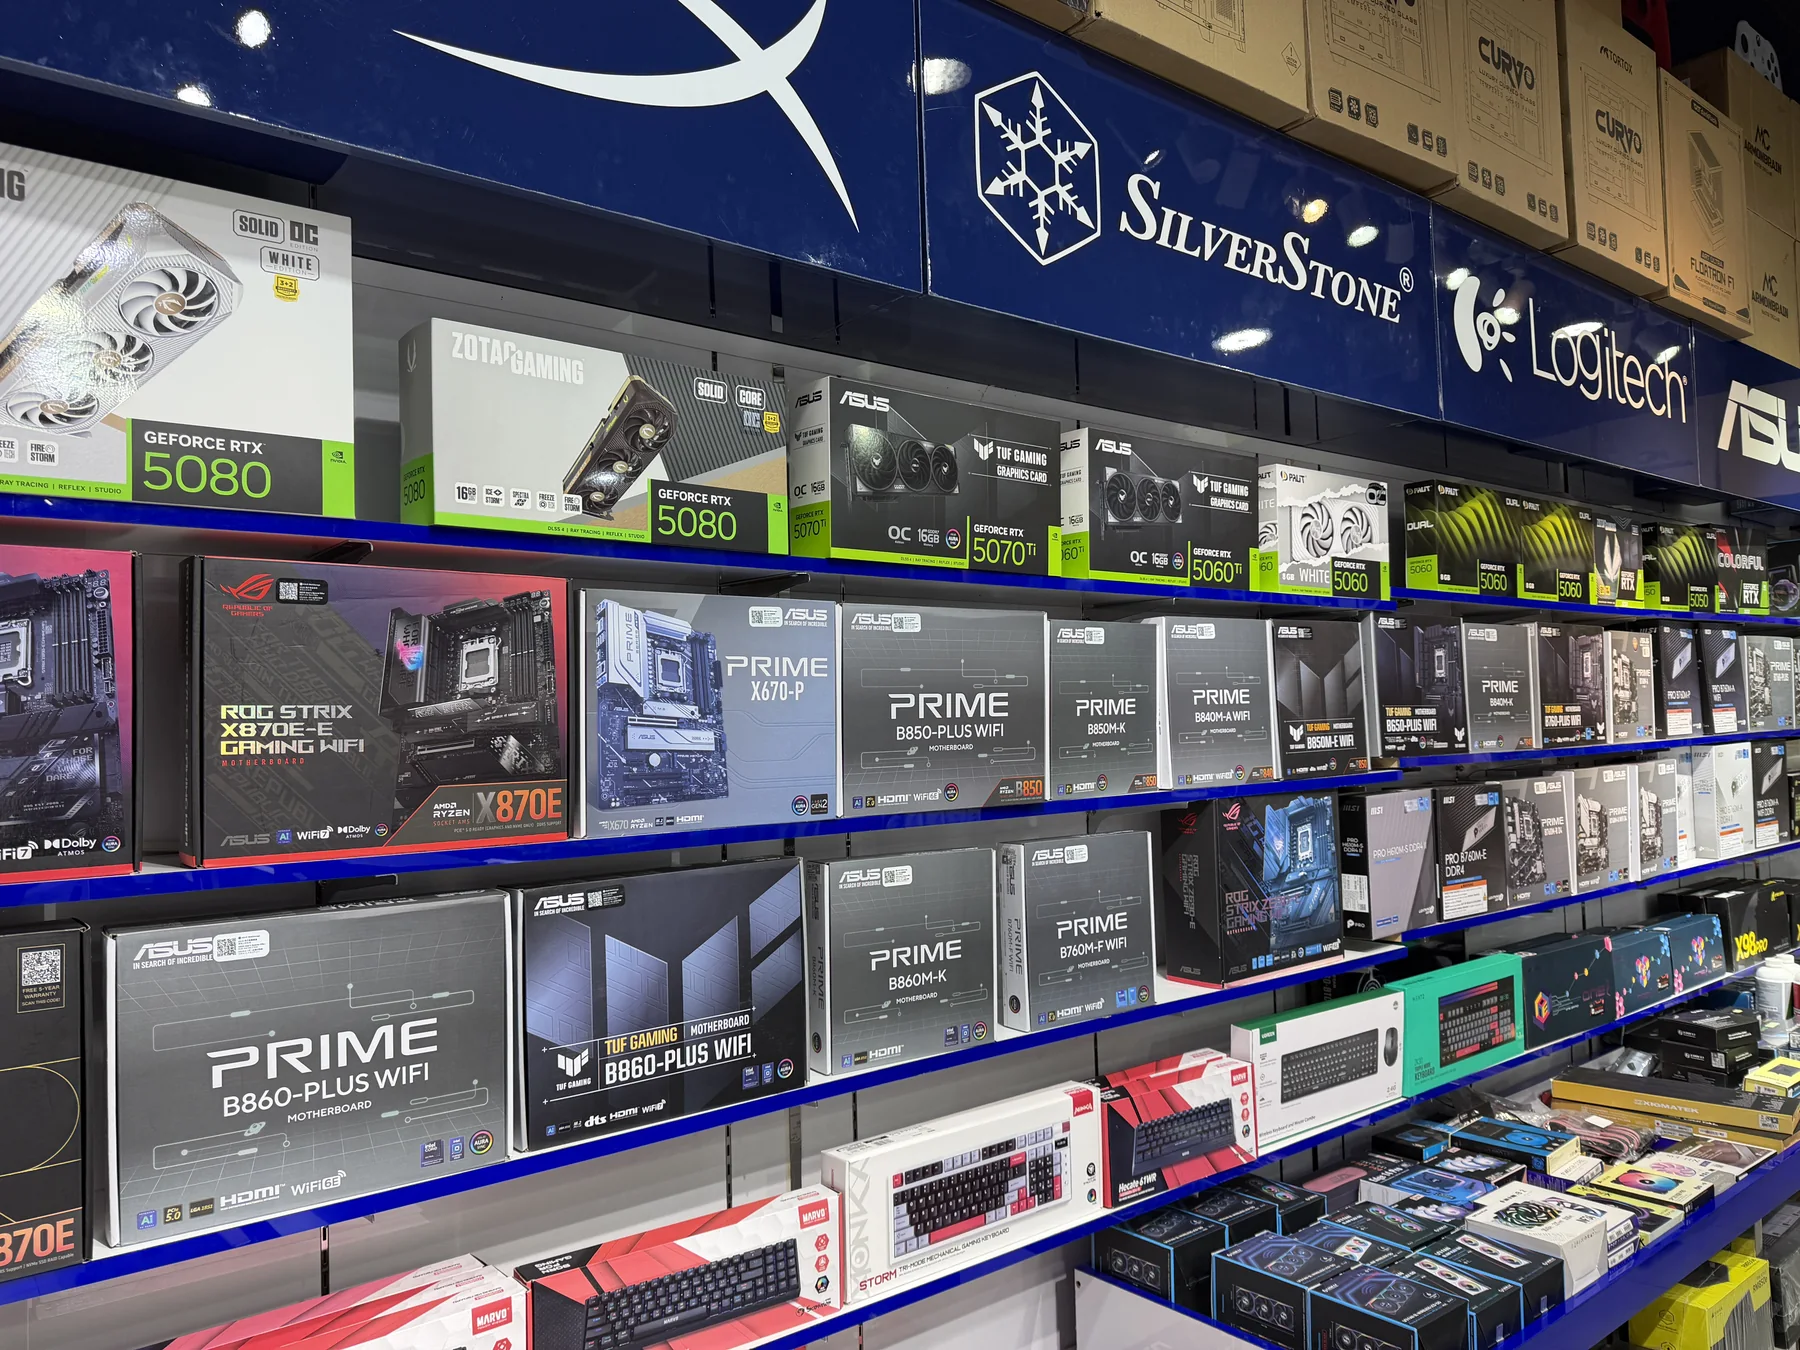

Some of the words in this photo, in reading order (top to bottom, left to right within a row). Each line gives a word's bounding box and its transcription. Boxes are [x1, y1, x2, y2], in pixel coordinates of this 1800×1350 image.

[1478, 36, 1535, 90] CURVO
[1595, 108, 1642, 155] CURVO
[239, 215, 279, 238] SOLID
[289, 220, 318, 246] OC
[268, 250, 312, 271] WHITE
[451, 331, 516, 365] ZOTAC
[511, 351, 585, 385] GAMING
[1529, 297, 1687, 423] Logitech
[697, 381, 724, 400] SOLID
[739, 389, 762, 406] CORE
[794, 390, 823, 409] ASUS
[839, 390, 890, 413] ASUS
[30, 443, 45, 452] FIRE
[143, 430, 226, 451] GEFORCE
[229, 441, 264, 455] RTX
[1095, 438, 1132, 456] ASUS
[30, 452, 56, 463] STORM
[996, 445, 1012, 460] TUF
[1013, 448, 1048, 467] GAMING
[142, 451, 272, 499] 5080
[996, 465, 1029, 480] GRAPHICS
[1030, 468, 1048, 483] CARD
[16, 480, 49, 489] TRACING
[58, 484, 86, 492] REFLEX
[94, 486, 122, 494] STUDIO
[403, 478, 426, 506] 5080
[1209, 481, 1223, 493] TUF
[1223, 483, 1249, 498] GAMING
[658, 488, 709, 503] GEFORCE
[710, 495, 732, 506] RTX
[564, 503, 581, 513] STORM
[657, 504, 737, 541] 5080
[973, 523, 1007, 536] GEFORCE
[1008, 527, 1024, 538] RTX
[1406, 520, 1434, 531] DUAL
[972, 537, 1025, 566] 5070
[1026, 542, 1036, 556] Ti
[1193, 547, 1218, 558] GEFORCE
[1219, 550, 1232, 559] RTX
[1410, 564, 1433, 575] 5060
[1717, 552, 1765, 571] COLORFUL
[1192, 560, 1233, 584] 5060
[1234, 561, 1242, 575] Ti
[1299, 567, 1330, 584] WHITE
[1334, 571, 1368, 592] 5060
[1480, 572, 1508, 591] 5060
[1559, 581, 1582, 598] 5060
[1621, 578, 1635, 591] RTX
[1690, 593, 1708, 608] 5050
[1743, 590, 1759, 604] RTX
[784, 608, 828, 621] ASUS
[851, 613, 892, 625] ASUS
[1377, 617, 1395, 627] ASUS
[1057, 628, 1085, 638] ASUS
[1171, 624, 1198, 634] ASUS
[1277, 626, 1298, 635] ASUS
[1468, 628, 1485, 637] ASUS
[725, 655, 828, 677] PRIME
[750, 680, 805, 702] X670-P
[1481, 680, 1519, 693] PRIME
[1192, 688, 1250, 705] PRIME
[220, 704, 274, 719] ROG
[279, 704, 353, 719] STRIX
[888, 692, 1009, 720] PRIME
[1076, 698, 1136, 716] PRIME
[1385, 707, 1395, 716] TUF
[1394, 707, 1412, 716] GAMING
[1194, 711, 1233, 723] B840M-A
[1233, 710, 1251, 721] WIFI
[1386, 719, 1423, 732] B650-PLUS
[1422, 718, 1437, 731] WIFI
[220, 722, 334, 738] X870E-E
[896, 724, 973, 740] B850-PLUS
[974, 723, 1004, 738] WIFI
[1087, 722, 1126, 735] B850M-K
[220, 739, 315, 756] GAMING
[319, 738, 365, 753] WIFI
[928, 743, 974, 752] MOTHERBOARD
[1307, 736, 1338, 750] B850M-E
[1338, 733, 1354, 747] WIFI
[72, 746, 93, 755] FOR
[221, 757, 305, 767] MOTHERBOARD
[1015, 779, 1043, 797] B850
[433, 802, 451, 810] AMD
[476, 788, 563, 824] X870E
[878, 794, 909, 804] HDMI
[433, 808, 471, 818] RYZEN
[1541, 816, 1565, 827] PRIME
[61, 837, 97, 849] Dolby
[57, 849, 85, 857] ATMOS
[1031, 847, 1064, 862] ASUS
[1445, 853, 1460, 865] PRO
[1460, 848, 1487, 863] B760M-E
[839, 868, 881, 883] ASUS
[1445, 864, 1465, 878] DDR4
[533, 892, 585, 911] ASUS
[1056, 911, 1128, 940] PRIME
[133, 936, 214, 961] ASUS
[1060, 940, 1104, 960] B760M-F
[1105, 936, 1128, 951] WIFI
[1735, 931, 1756, 962] X98
[1755, 937, 1768, 953] PRO
[132, 962, 140, 970] IN
[140, 959, 166, 970] SEARCH
[167, 958, 176, 966] OF
[176, 953, 214, 965] INCREDIBLE
[868, 939, 963, 973] PRIME
[1180, 965, 1201, 976] ASUS
[1228, 964, 1248, 976] ASUS
[888, 968, 948, 992] B860M-K
[24, 991, 57, 999] WARRANTY
[895, 991, 939, 1005] MOTHERBOARD
[690, 1014, 750, 1037] MOTHERBOARD
[604, 1037, 628, 1056] TUF
[629, 1027, 678, 1051] GAMING
[206, 1017, 438, 1089] PRIME
[605, 1042, 709, 1086] B860-PLUS
[714, 1032, 752, 1061] WIFI
[869, 1045, 901, 1058] HDMI
[223, 1073, 370, 1118] B860-PLUS
[373, 1062, 429, 1090] WIFI
[556, 1081, 567, 1091] TUF
[567, 1076, 591, 1088] GAMING
[287, 1100, 372, 1124] MOTHERBOARD
[1642, 1099, 1700, 1115] XIGMATEK
[584, 1114, 607, 1128] dts
[609, 1107, 638, 1121] HDMI
[1118, 1178, 1139, 1194] Hecate
[219, 1184, 280, 1208] HDMI
[165, 1211, 181, 1223] 5.0
[802, 1208, 827, 1223] MARVO
[898, 1256, 926, 1273] TRI-MODE
[926, 1244, 961, 1264] MECHANICAL
[960, 1236, 982, 1252] GAMING
[981, 1226, 1010, 1246] KEYBOARD
[859, 1268, 897, 1292] STORM
[476, 1309, 508, 1329] MARVO
